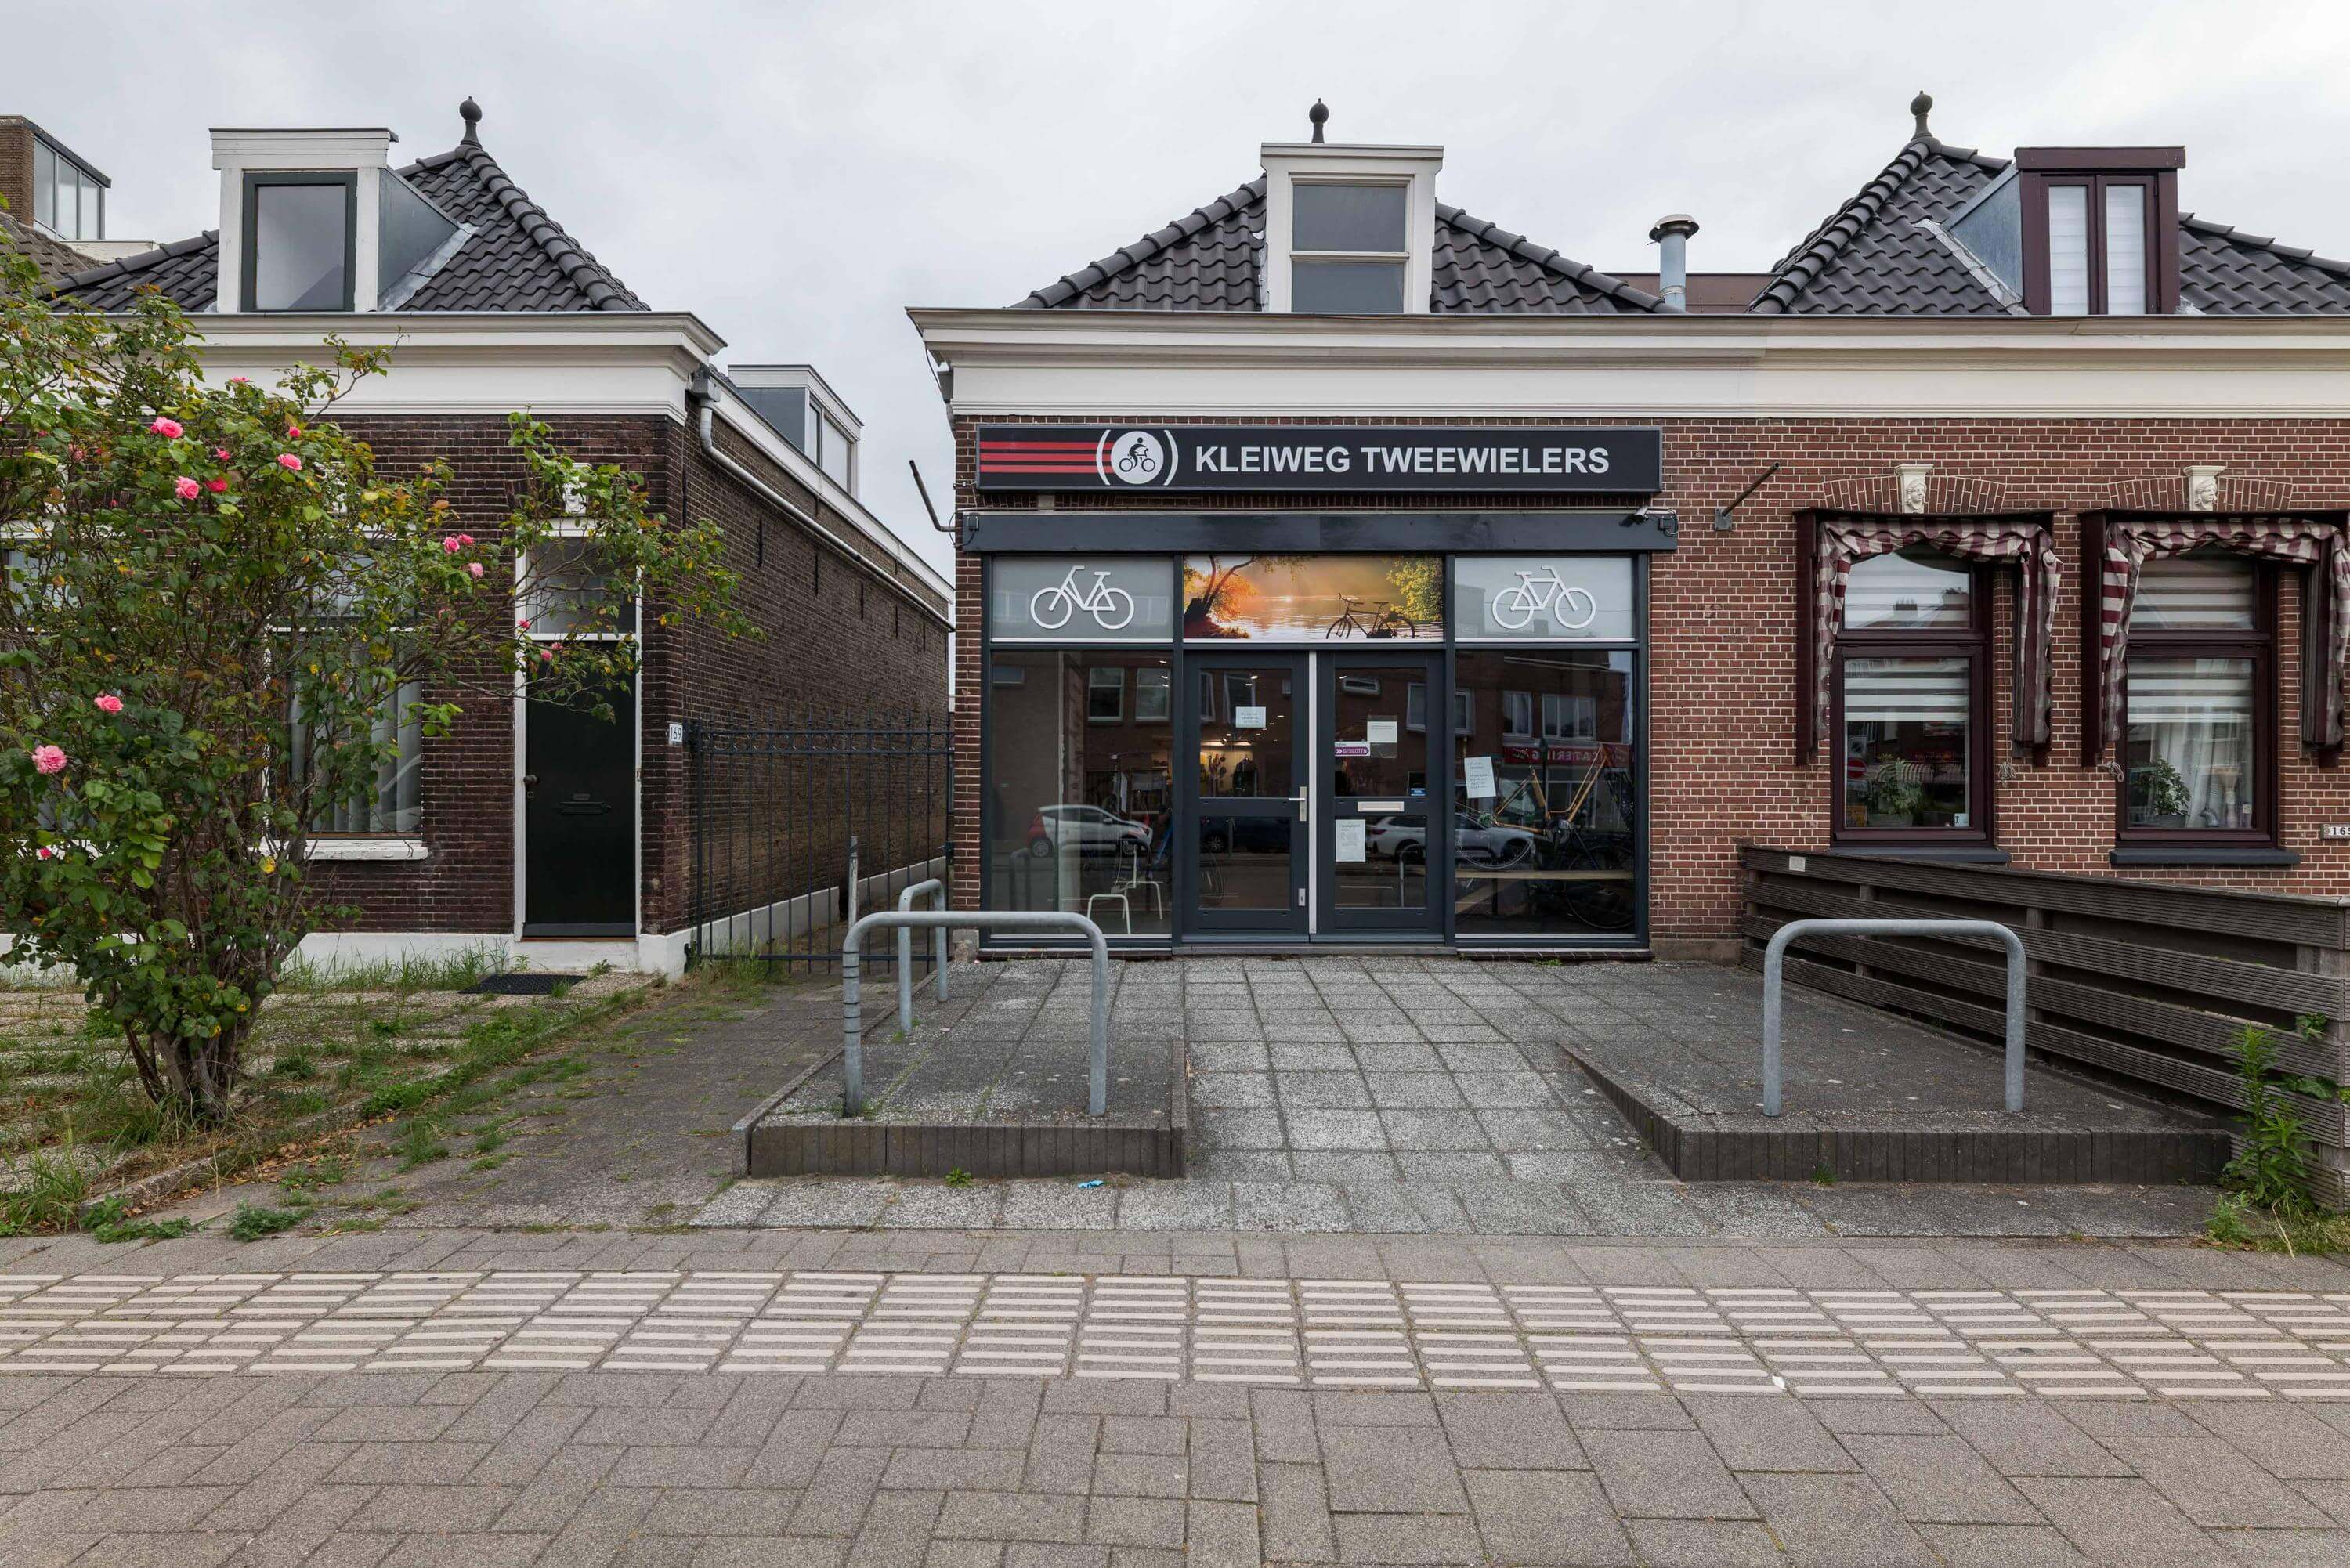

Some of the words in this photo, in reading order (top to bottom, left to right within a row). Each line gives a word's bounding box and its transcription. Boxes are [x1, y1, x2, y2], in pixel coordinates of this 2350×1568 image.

[1195, 446, 1350, 473] KLEIWEG
[1360, 446, 1610, 474] TWEEWIELERS
[671, 726, 682, 739] 169
